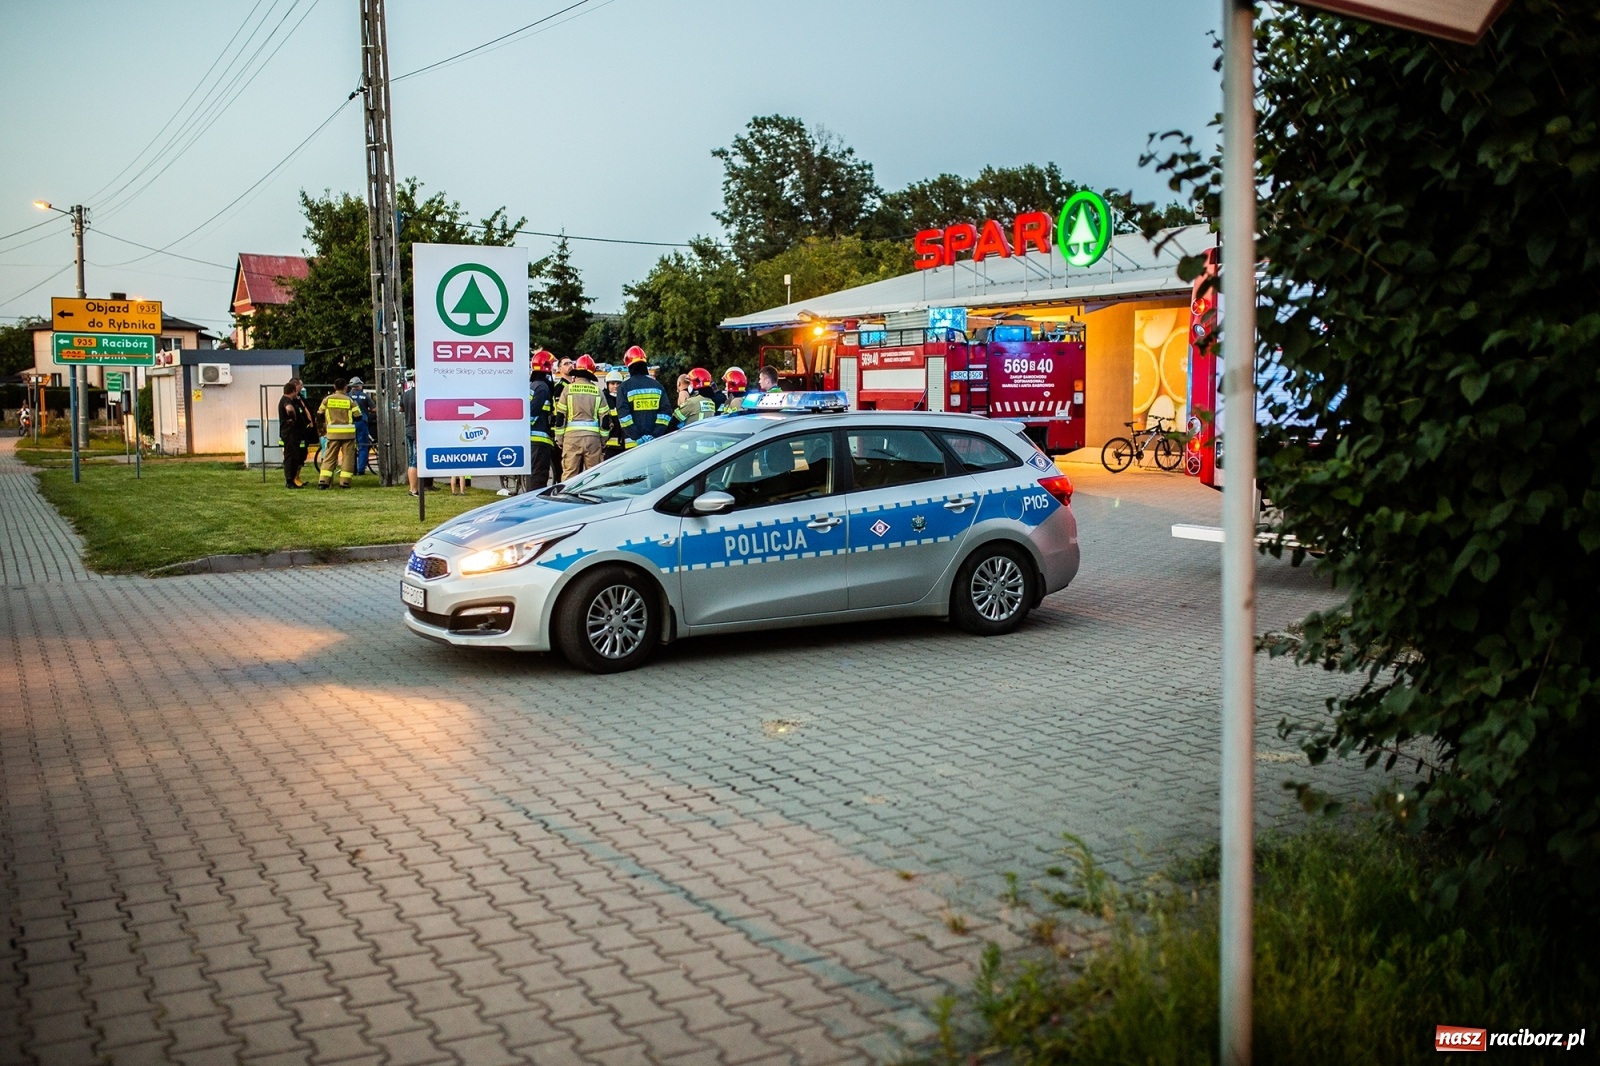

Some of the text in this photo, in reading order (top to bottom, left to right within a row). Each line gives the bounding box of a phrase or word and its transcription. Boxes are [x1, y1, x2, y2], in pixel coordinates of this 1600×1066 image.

[914, 212, 1052, 269] SPAR
[86, 302, 156, 315] Objazd 935
[88, 318, 156, 331] do Rybnika
[76, 337, 148, 348] 935 Racibórz
[436, 344, 510, 359] SPAR
[455, 367, 476, 375] Sklepy
[1003, 359, 1028, 373] 569
[1037, 359, 1053, 373] 40
[432, 453, 489, 463] BANKOMAT
[1023, 494, 1049, 511] P105
[724, 529, 808, 557] POLICJA
